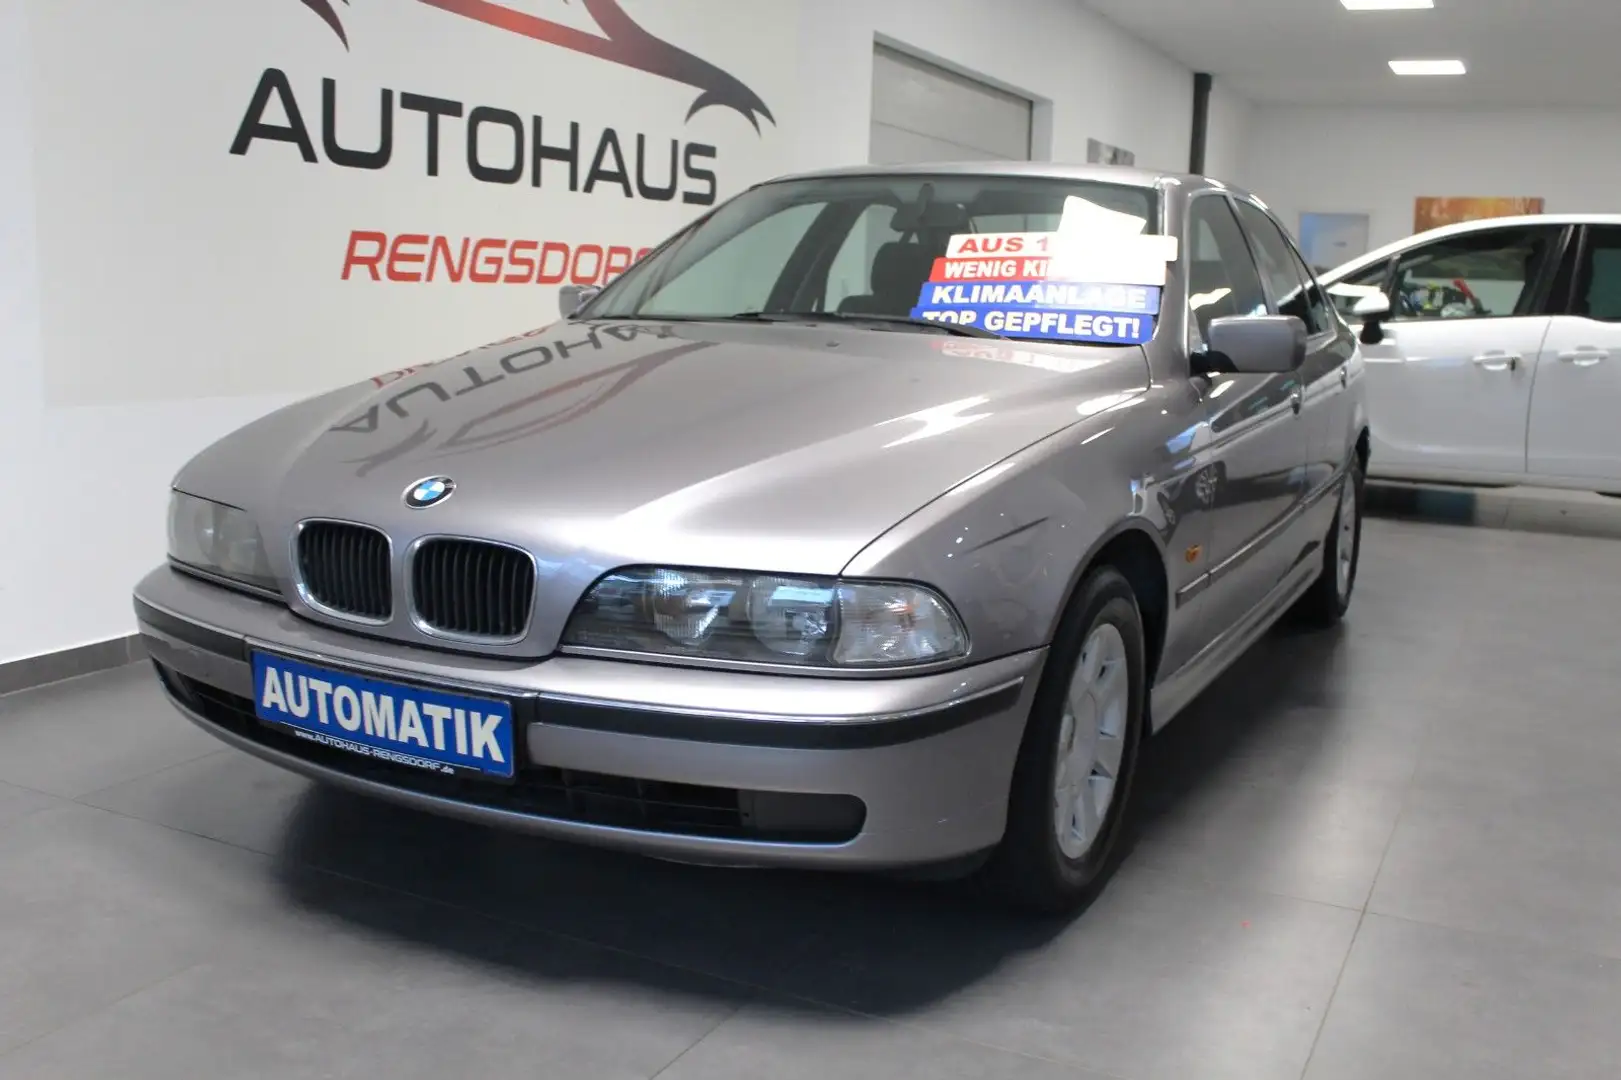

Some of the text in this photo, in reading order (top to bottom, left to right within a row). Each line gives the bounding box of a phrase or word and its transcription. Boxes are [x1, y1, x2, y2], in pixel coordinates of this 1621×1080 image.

[228, 67, 718, 206] AUTOHAUS
[958, 236, 1024, 254] AUS
[944, 260, 1017, 279] WENIG
[932, 285, 1147, 308] KLIMAANLAGE
[984, 312, 1141, 339] GEPFLEGT!
[262, 666, 505, 763] AUTOMATIK
